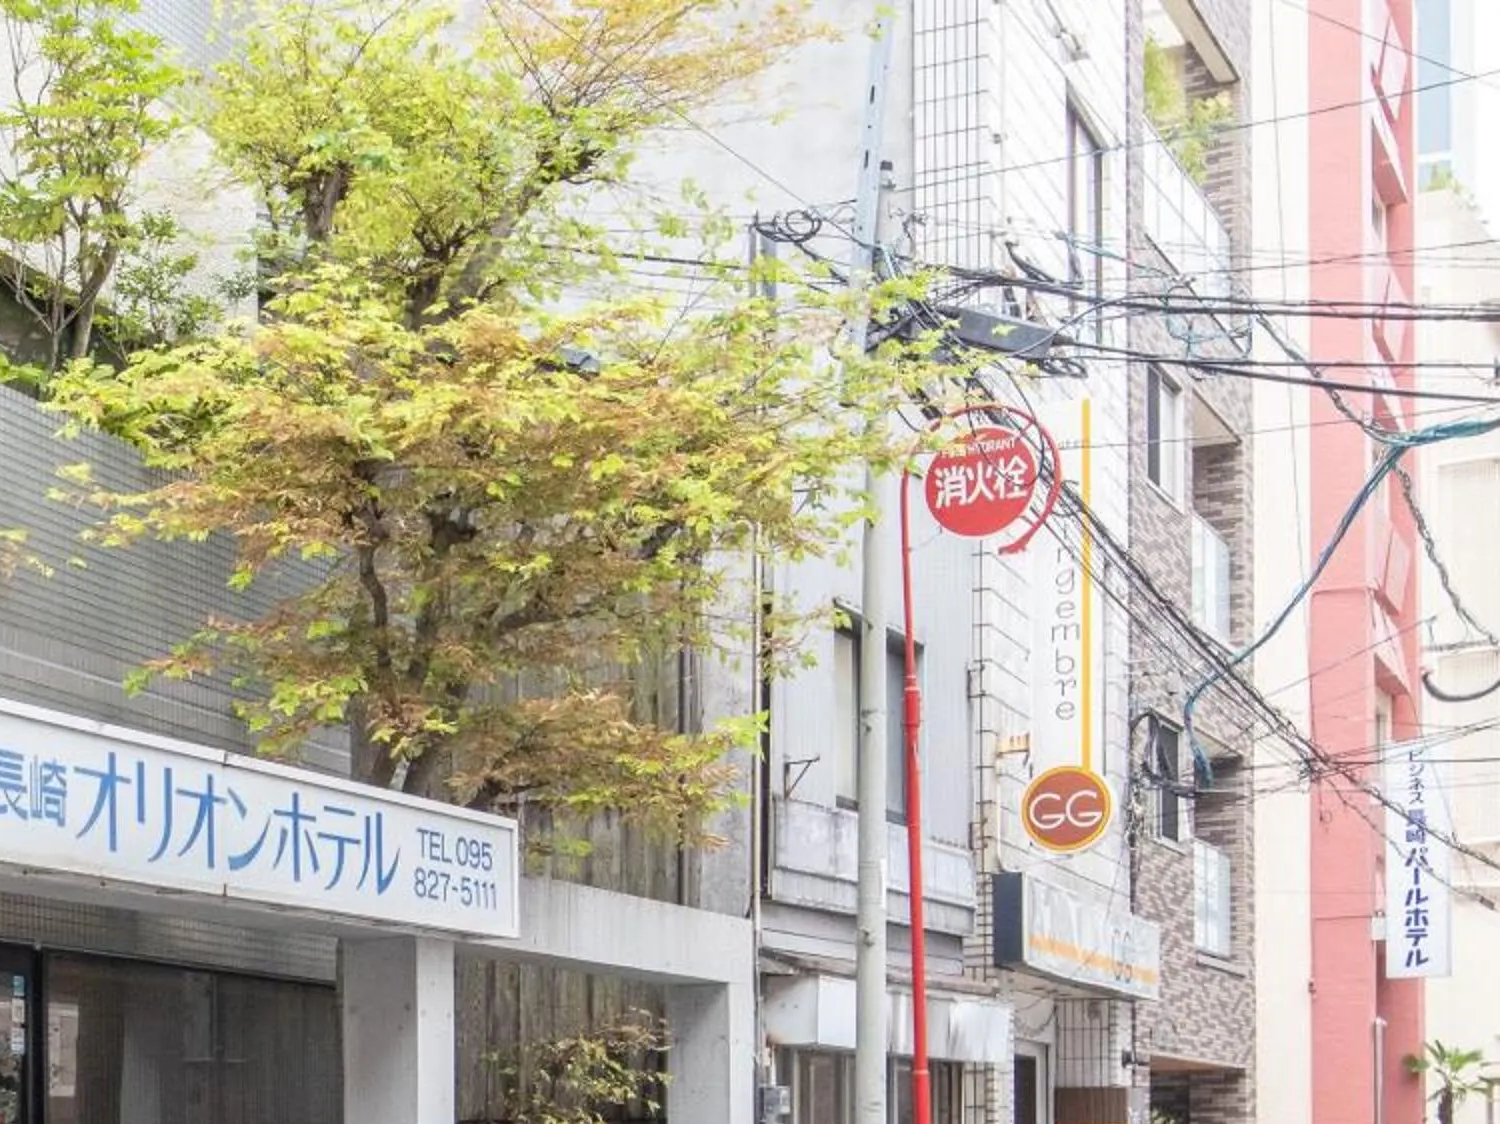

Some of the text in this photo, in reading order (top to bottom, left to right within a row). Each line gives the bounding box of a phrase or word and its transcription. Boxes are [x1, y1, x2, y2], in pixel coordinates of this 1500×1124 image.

[934, 455, 1029, 509] 消火栓
[1029, 789, 1103, 830] GG
[416, 827, 493, 871] TEL 095
[414, 867, 497, 910] 827-5111
